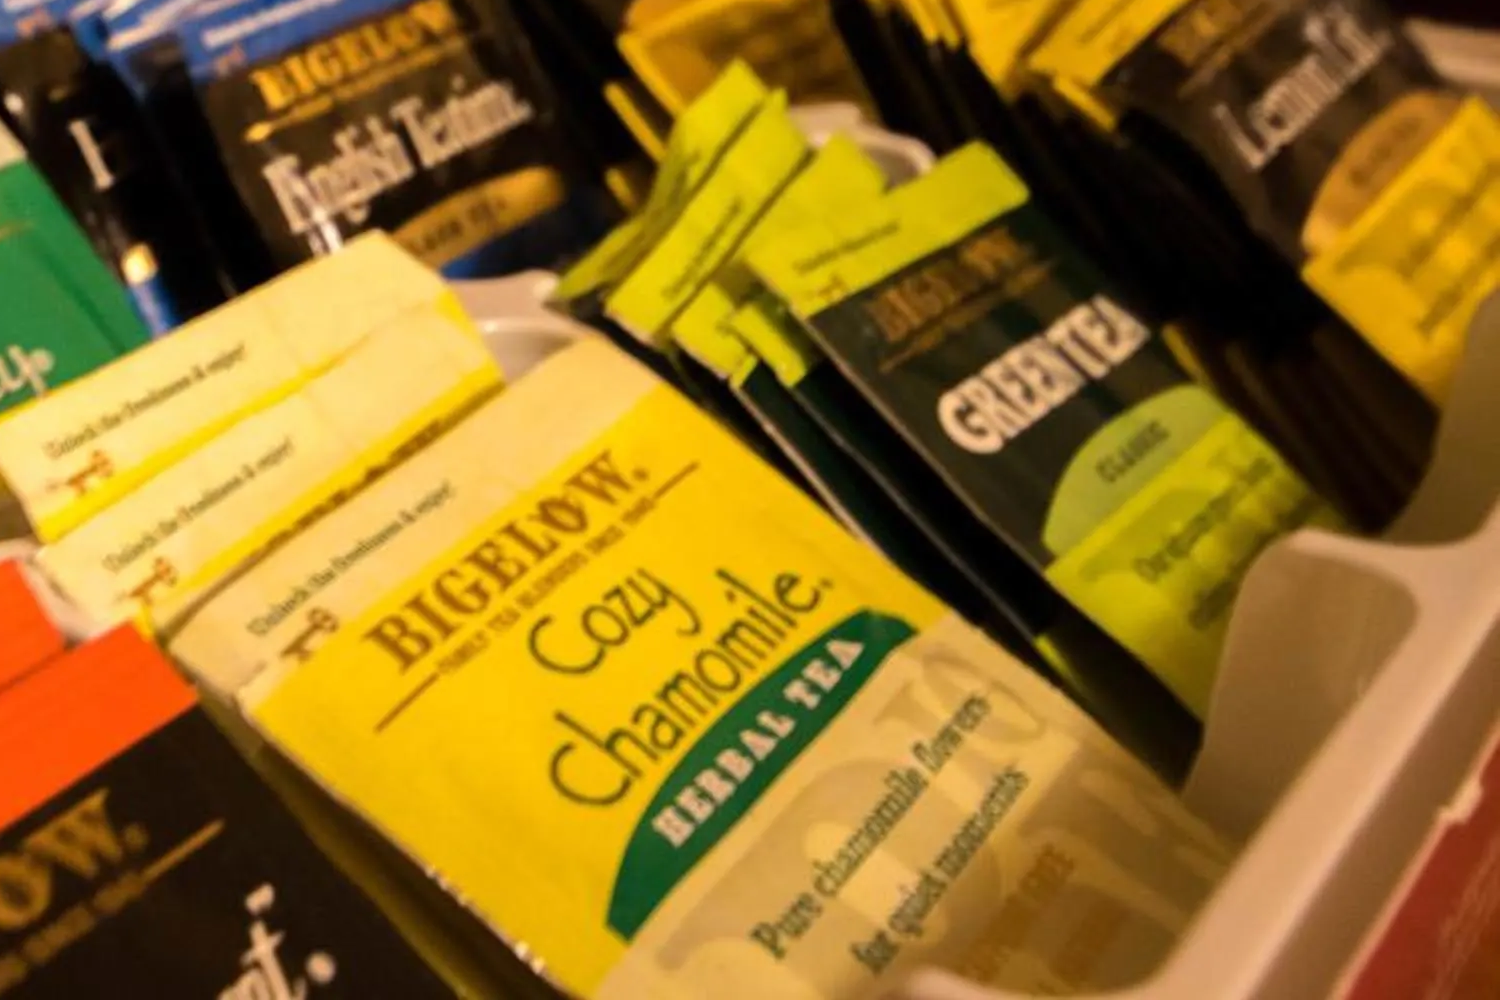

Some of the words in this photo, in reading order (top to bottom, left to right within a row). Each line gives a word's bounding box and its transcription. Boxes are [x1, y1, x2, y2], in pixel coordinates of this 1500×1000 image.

[937, 332, 1088, 454] GREEN
[1045, 294, 1151, 381] TEA
[363, 449, 635, 675] BIGELOW
[527, 567, 703, 677] Cozy
[651, 708, 797, 849] HERBAL
[783, 637, 865, 711] TEA
[750, 891, 823, 960] Pure
[811, 762, 930, 900] chamomile
[911, 693, 993, 775] flowers
[932, 761, 1031, 882] moments
